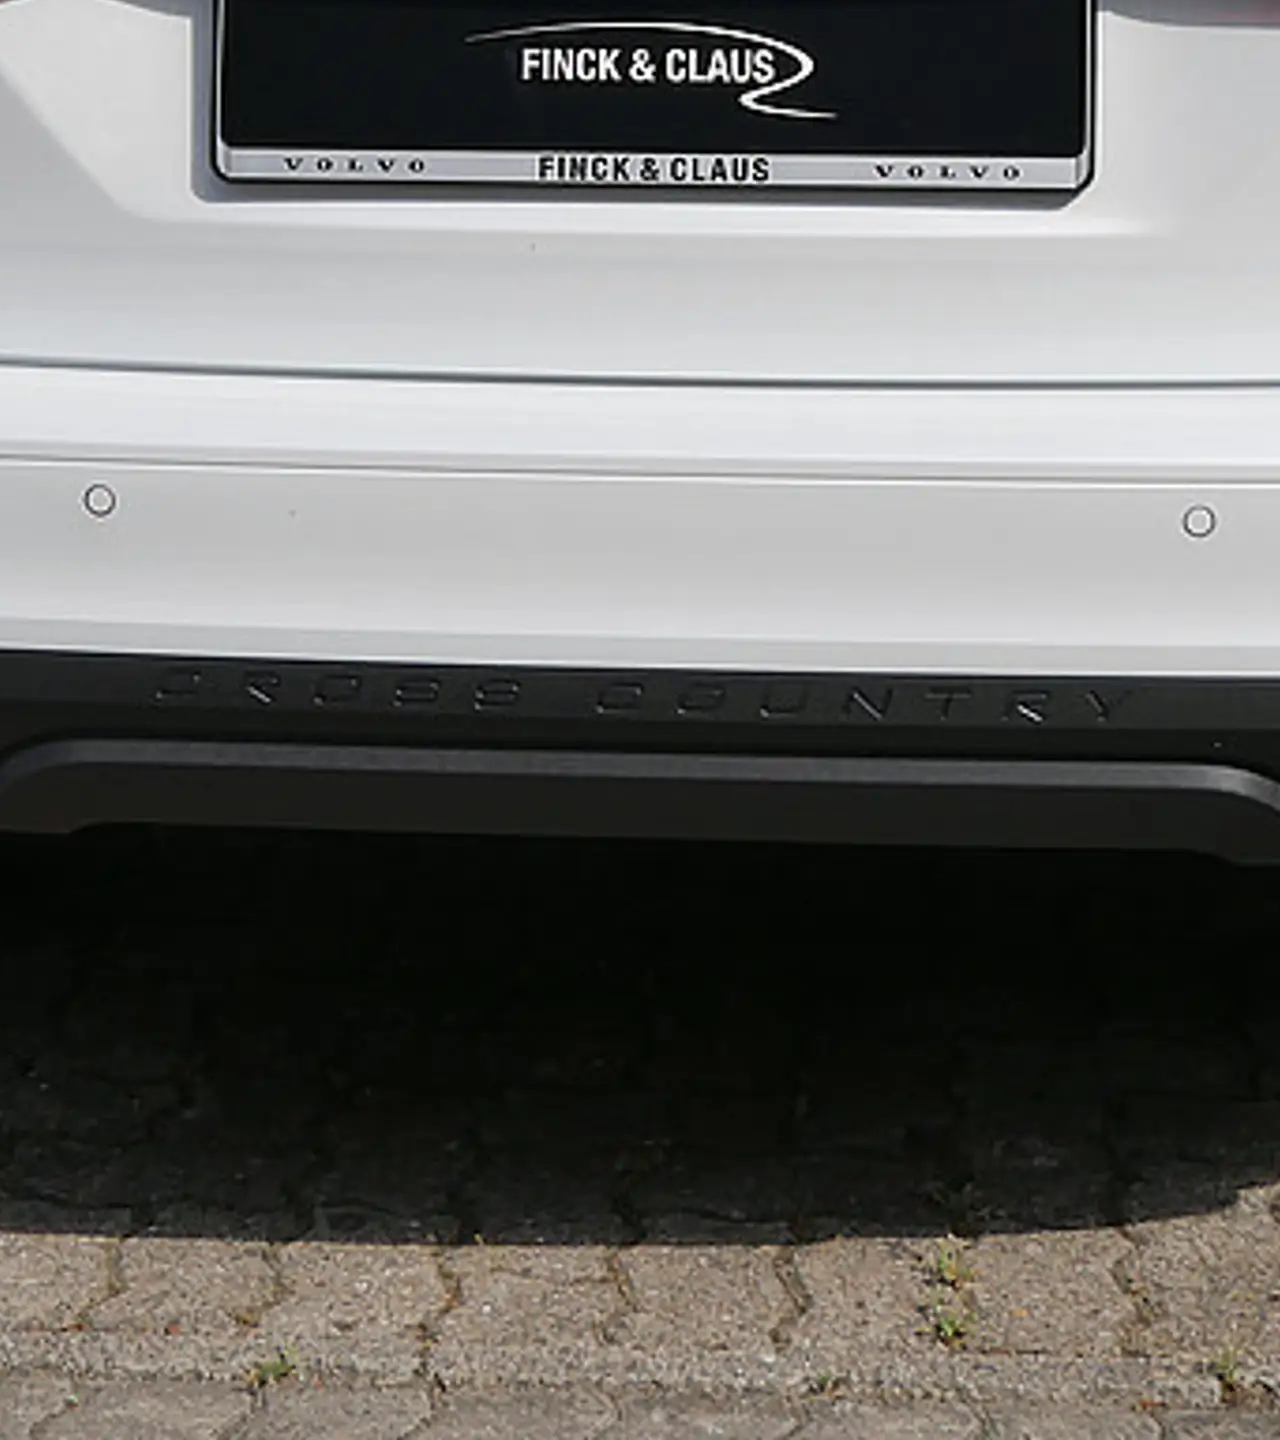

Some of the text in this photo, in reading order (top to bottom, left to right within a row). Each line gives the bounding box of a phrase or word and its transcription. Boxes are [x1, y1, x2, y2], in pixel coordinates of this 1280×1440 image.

[520, 45, 778, 86] FINCK & CLAUS
[280, 156, 429, 175] VOLVO
[537, 154, 772, 184] FINCK & CLAUS
[872, 162, 1024, 181] VOLVO
[152, 667, 1131, 726] CROSS COUNTRY
